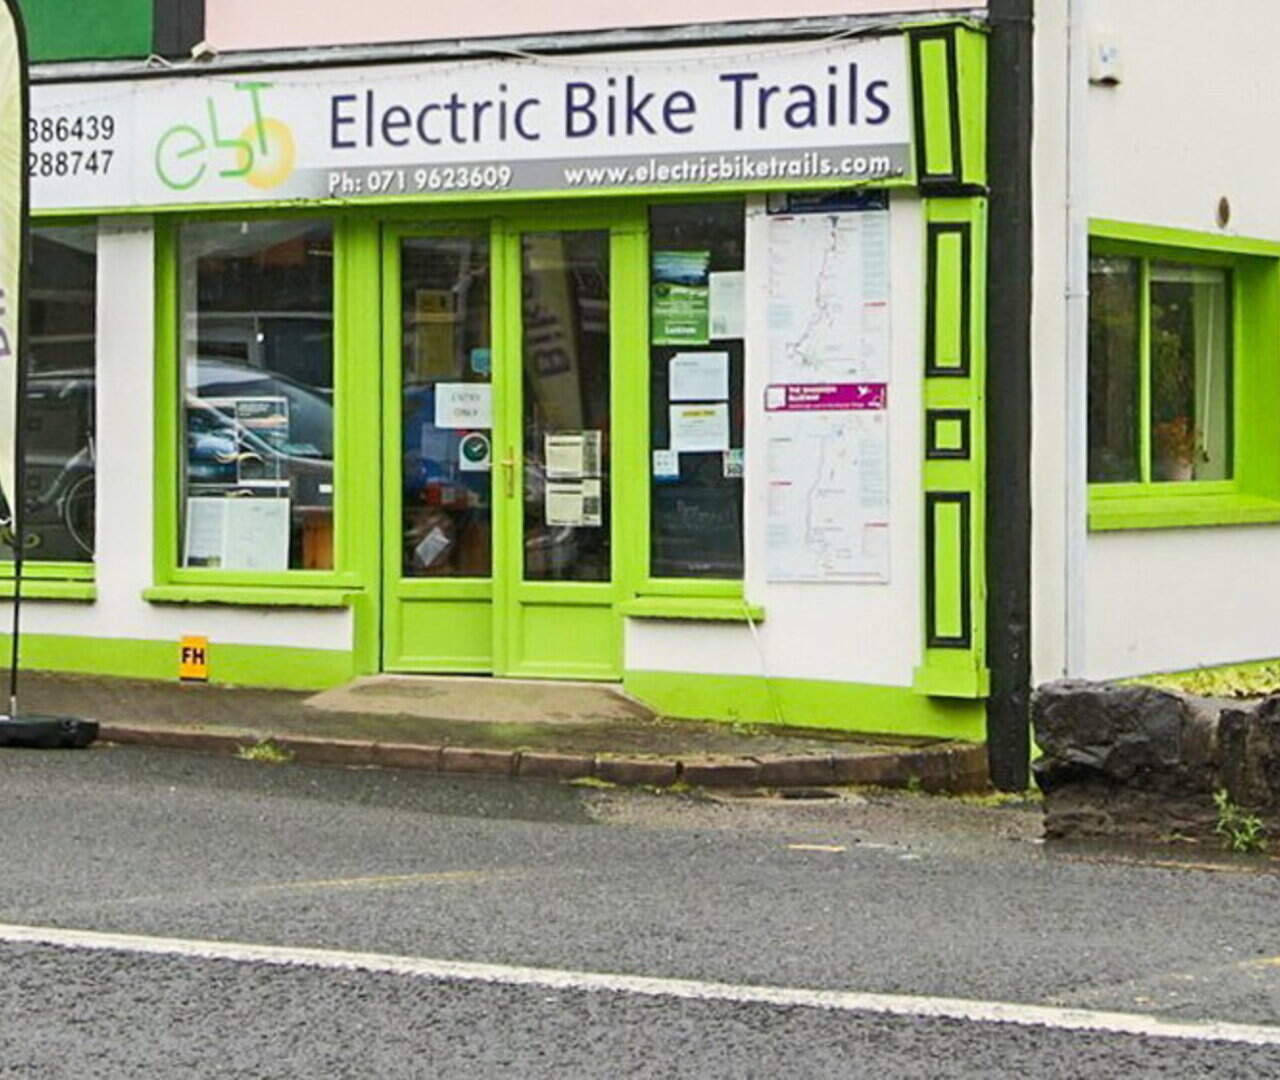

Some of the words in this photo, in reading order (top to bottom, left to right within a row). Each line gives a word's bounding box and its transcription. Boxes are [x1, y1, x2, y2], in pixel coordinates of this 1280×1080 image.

[331, 83, 542, 149] Electric
[565, 75, 697, 138] Bike
[720, 62, 892, 131] Trails
[328, 173, 362, 193] Ph:
[369, 171, 406, 192] 071
[414, 165, 512, 191] 9623609
[563, 152, 891, 186] www.electricbiketrails.com
[181, 647, 205, 665] FH
